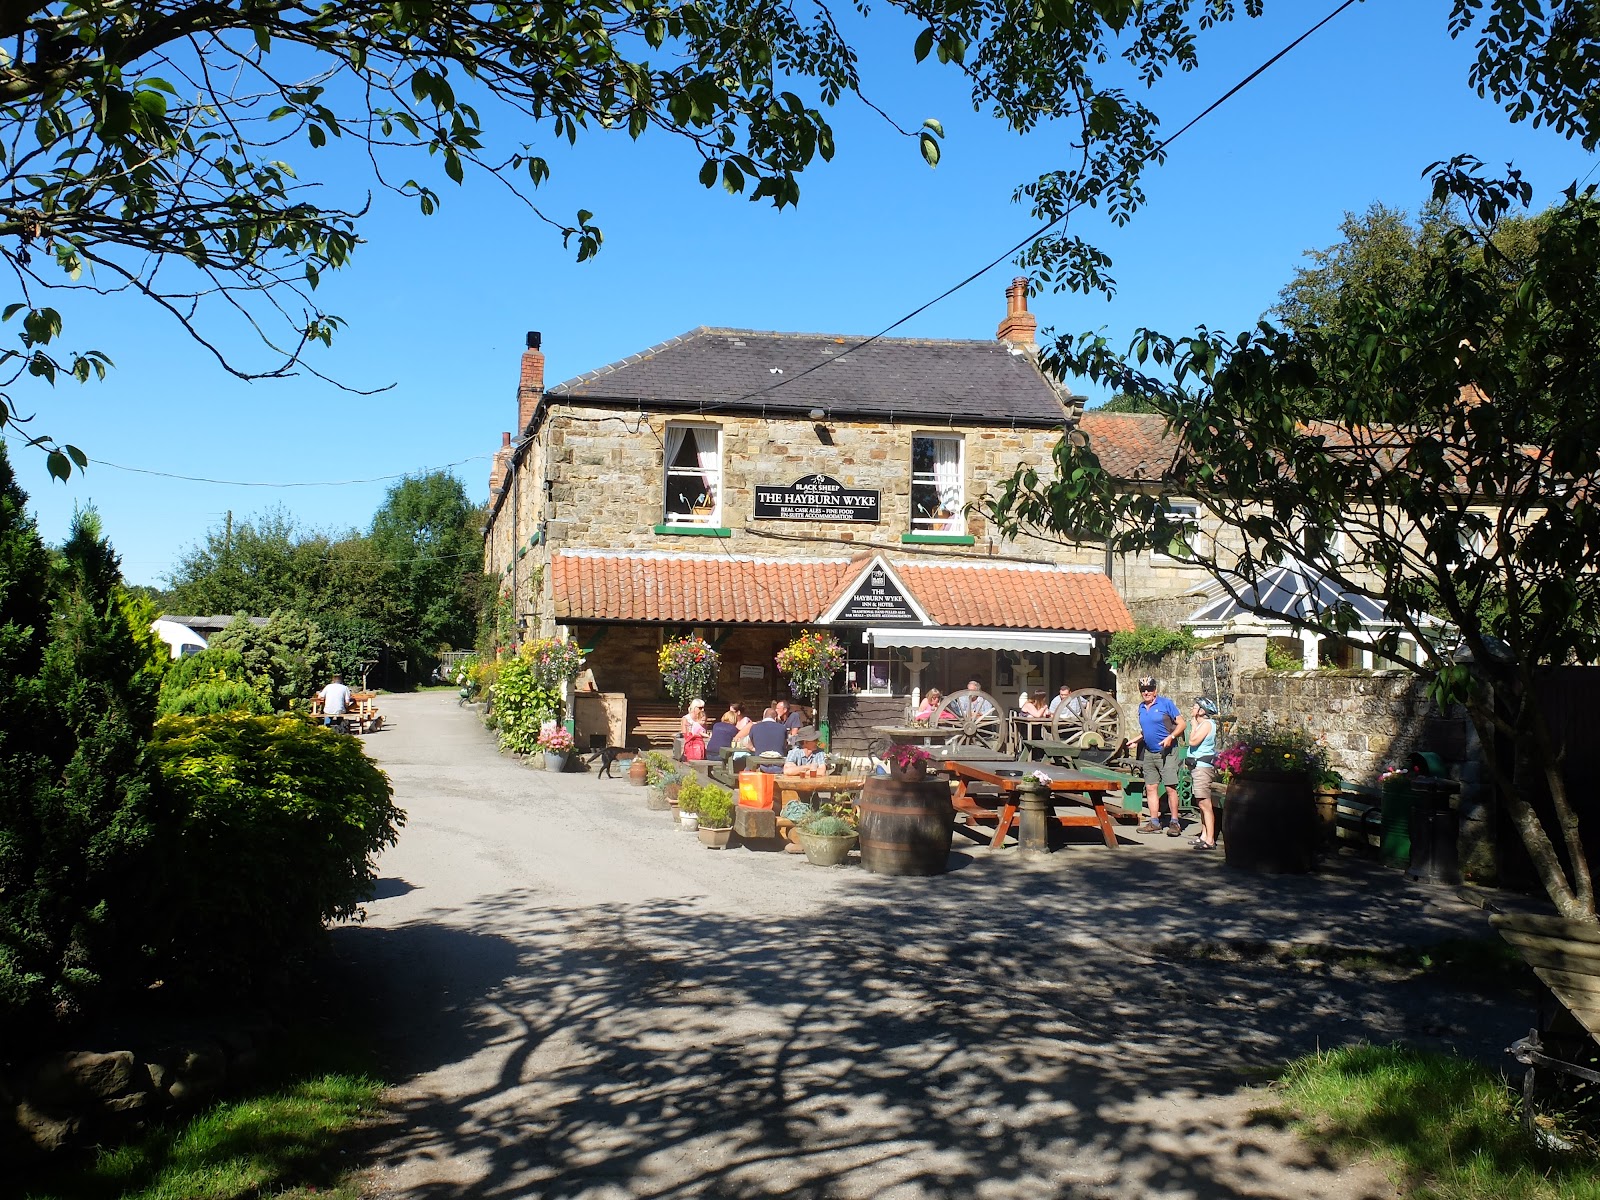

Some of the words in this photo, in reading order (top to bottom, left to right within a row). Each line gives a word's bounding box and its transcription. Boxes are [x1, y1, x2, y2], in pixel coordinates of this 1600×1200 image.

[758, 493, 782, 503] THE
[785, 494, 840, 505] HAYBURN
[842, 496, 876, 506] WYKE
